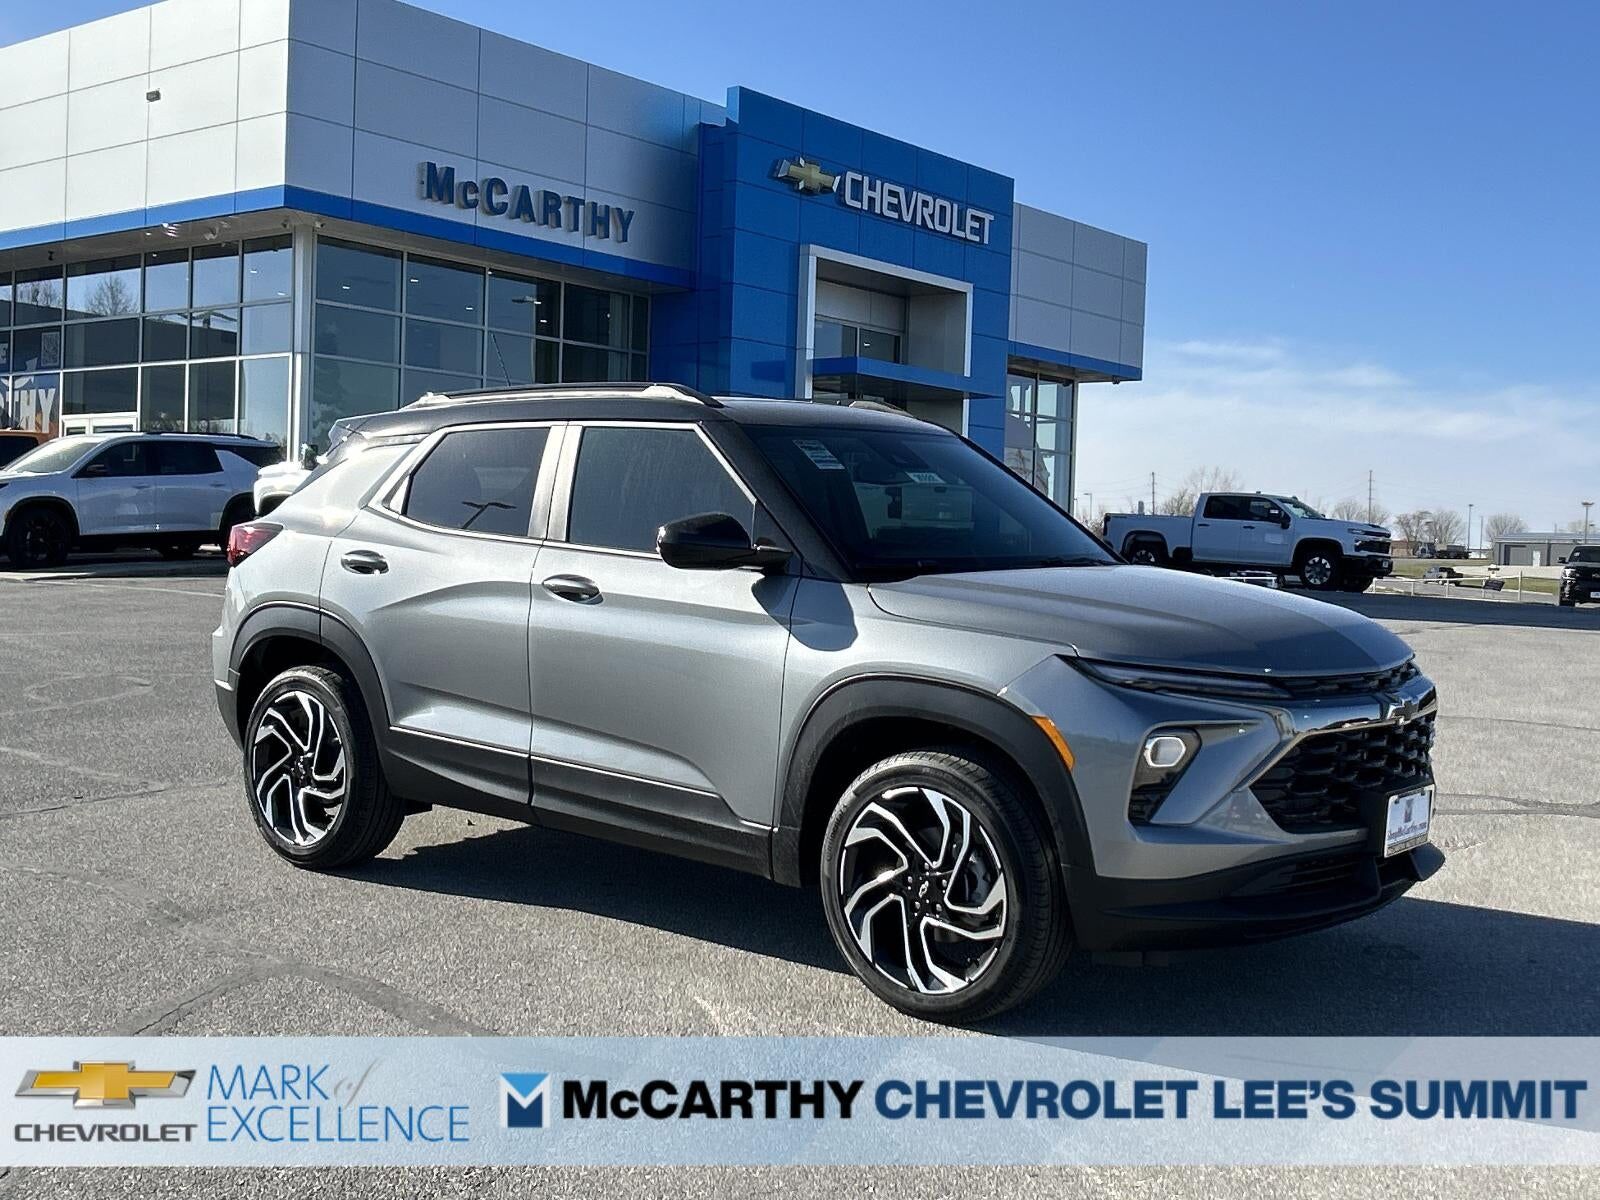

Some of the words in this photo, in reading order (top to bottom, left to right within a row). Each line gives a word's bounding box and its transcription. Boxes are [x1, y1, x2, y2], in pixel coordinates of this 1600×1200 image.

[418, 161, 635, 243] McCARTHY
[844, 170, 995, 245] CHEVROLET
[0, 388, 56, 434] THY
